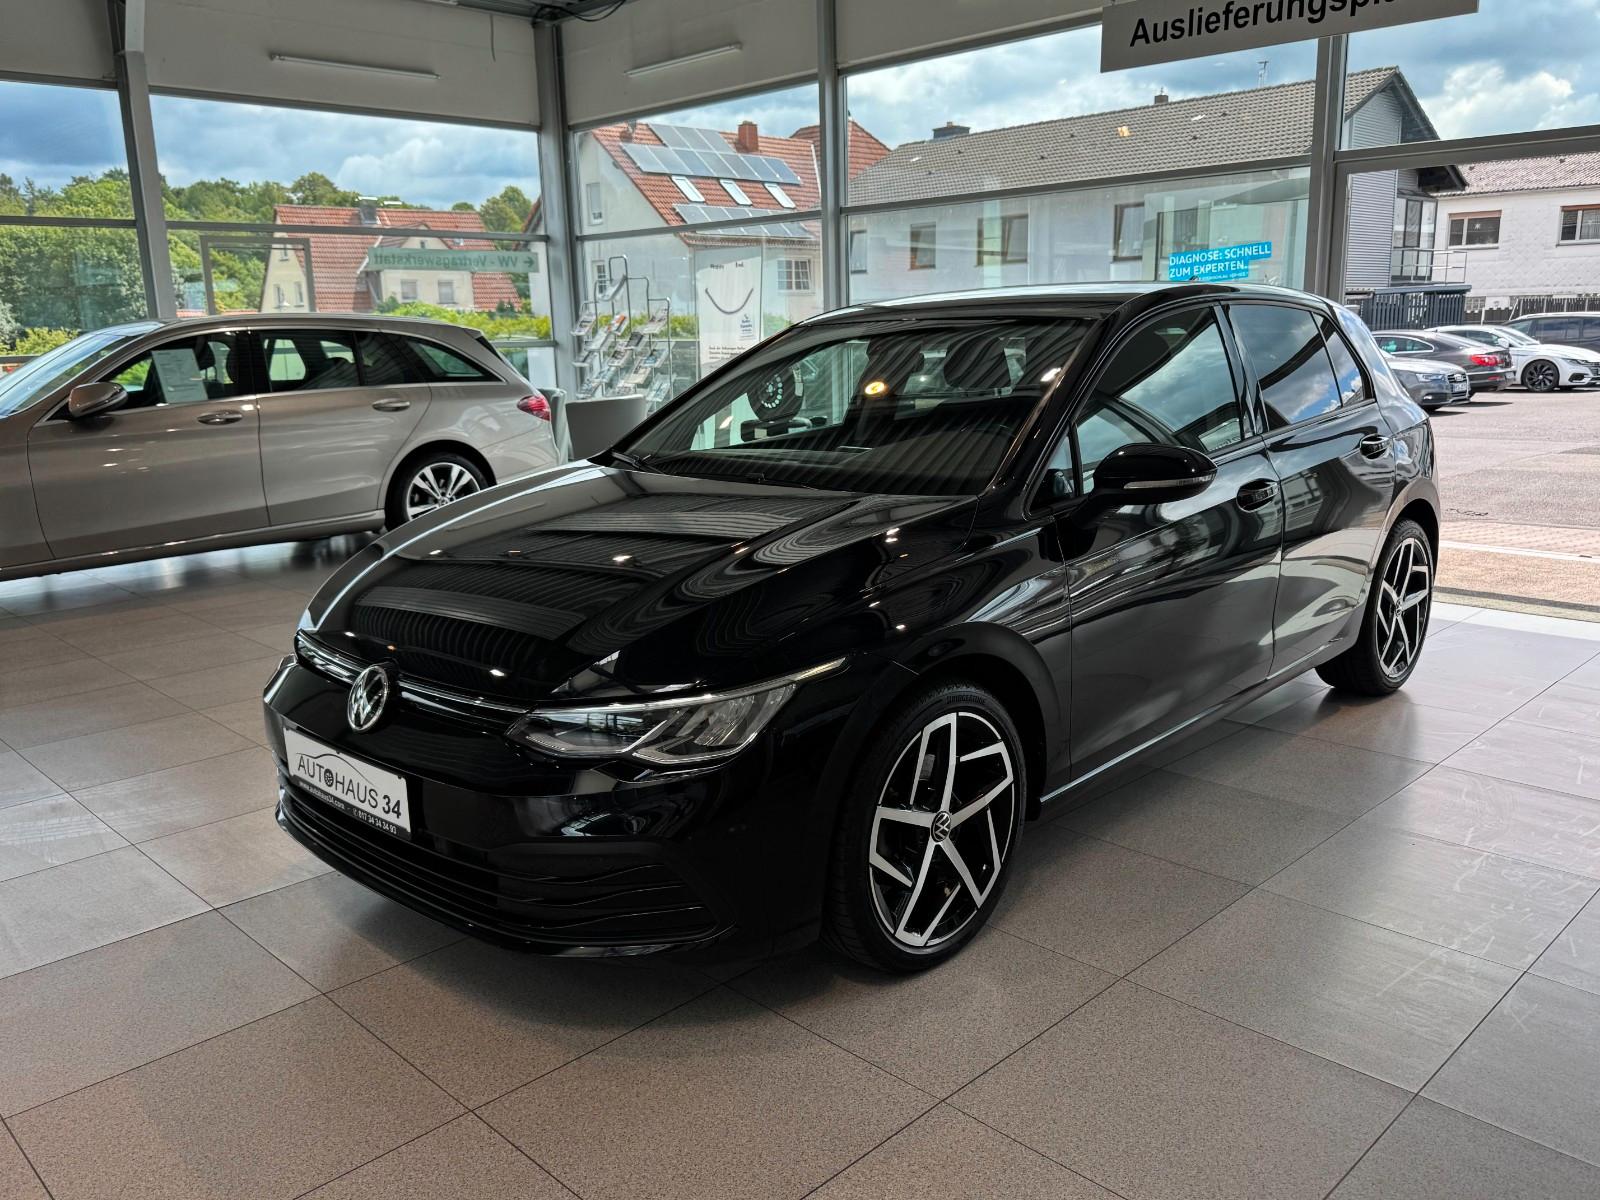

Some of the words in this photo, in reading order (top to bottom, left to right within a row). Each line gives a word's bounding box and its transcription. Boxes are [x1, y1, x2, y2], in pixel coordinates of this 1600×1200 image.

[1130, 0, 1395, 47] Auslieferungsp
[1169, 250, 1223, 266] DIAGNOSE:
[1224, 244, 1271, 259] SCHNELL
[1169, 267, 1191, 278] ZUM
[1193, 260, 1248, 276] EXPERTEN.
[297, 755, 379, 809] AUTOHAUS
[382, 794, 402, 819] 34
